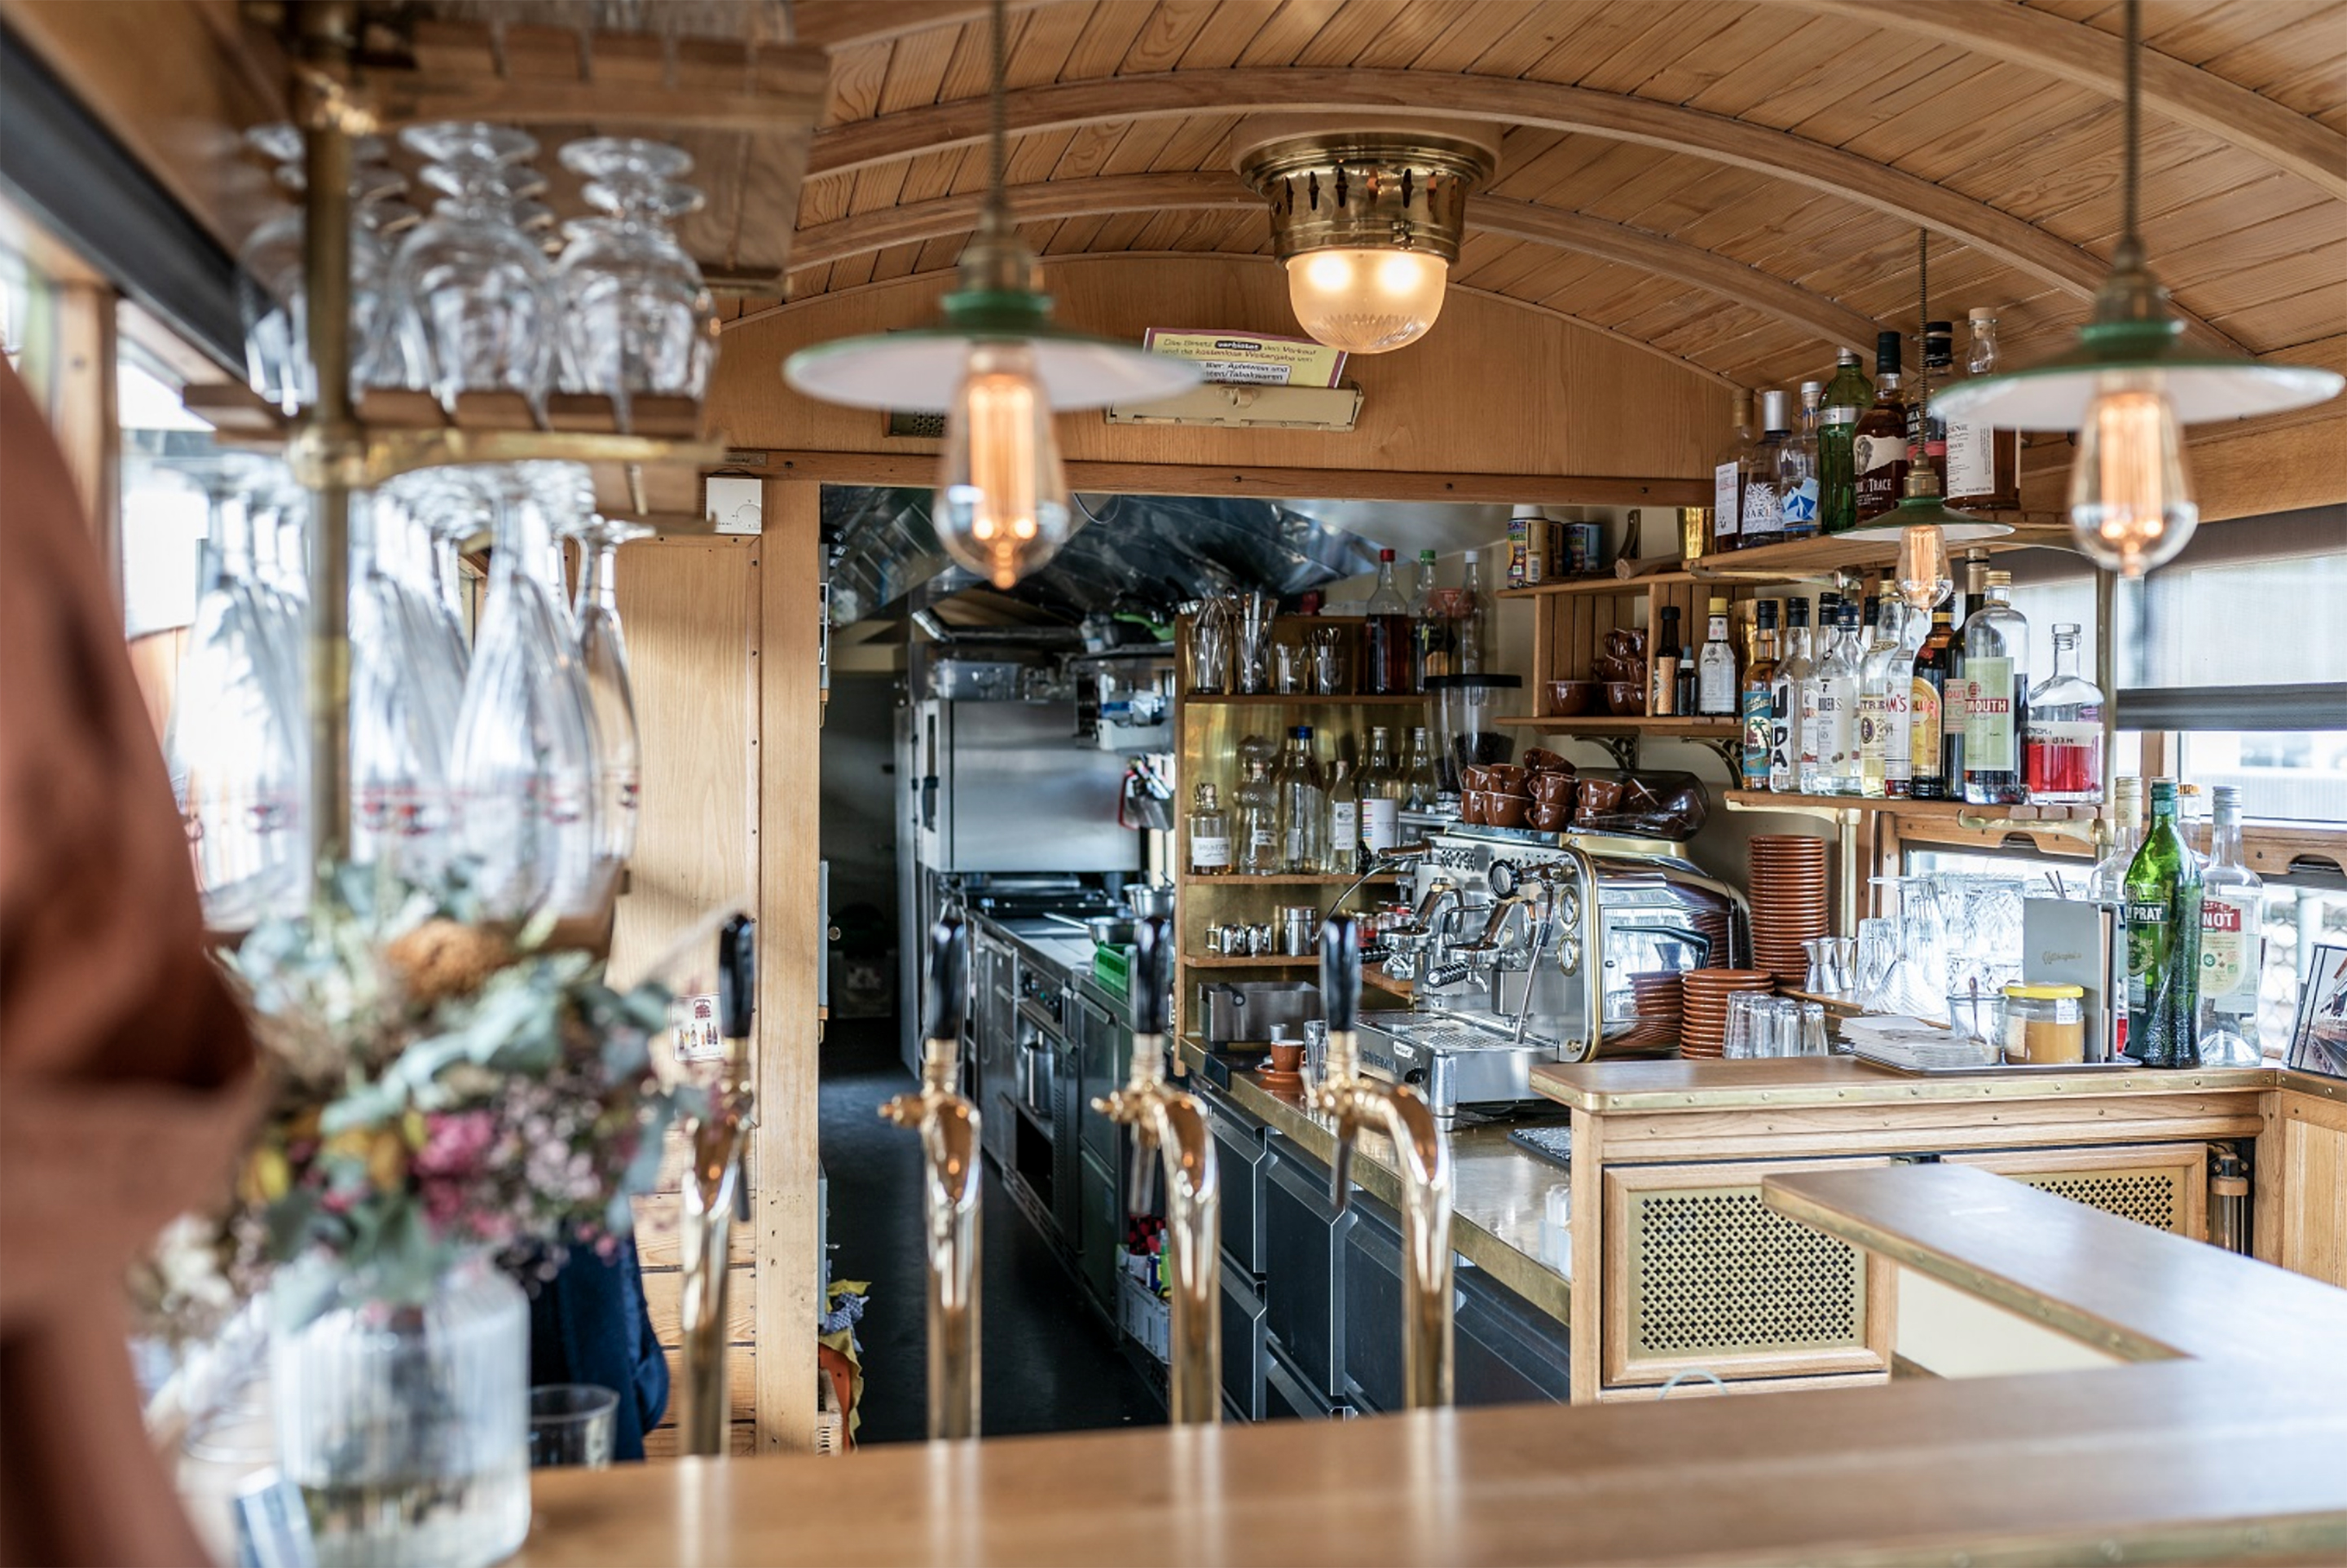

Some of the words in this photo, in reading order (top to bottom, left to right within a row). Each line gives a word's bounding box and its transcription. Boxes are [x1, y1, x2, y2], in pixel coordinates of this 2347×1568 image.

[1196, 348, 1242, 357] kostenlose
[1869, 478, 1891, 491] TRACE
[2133, 906, 2162, 921] PRAT
[2203, 912, 2235, 927] NOT
